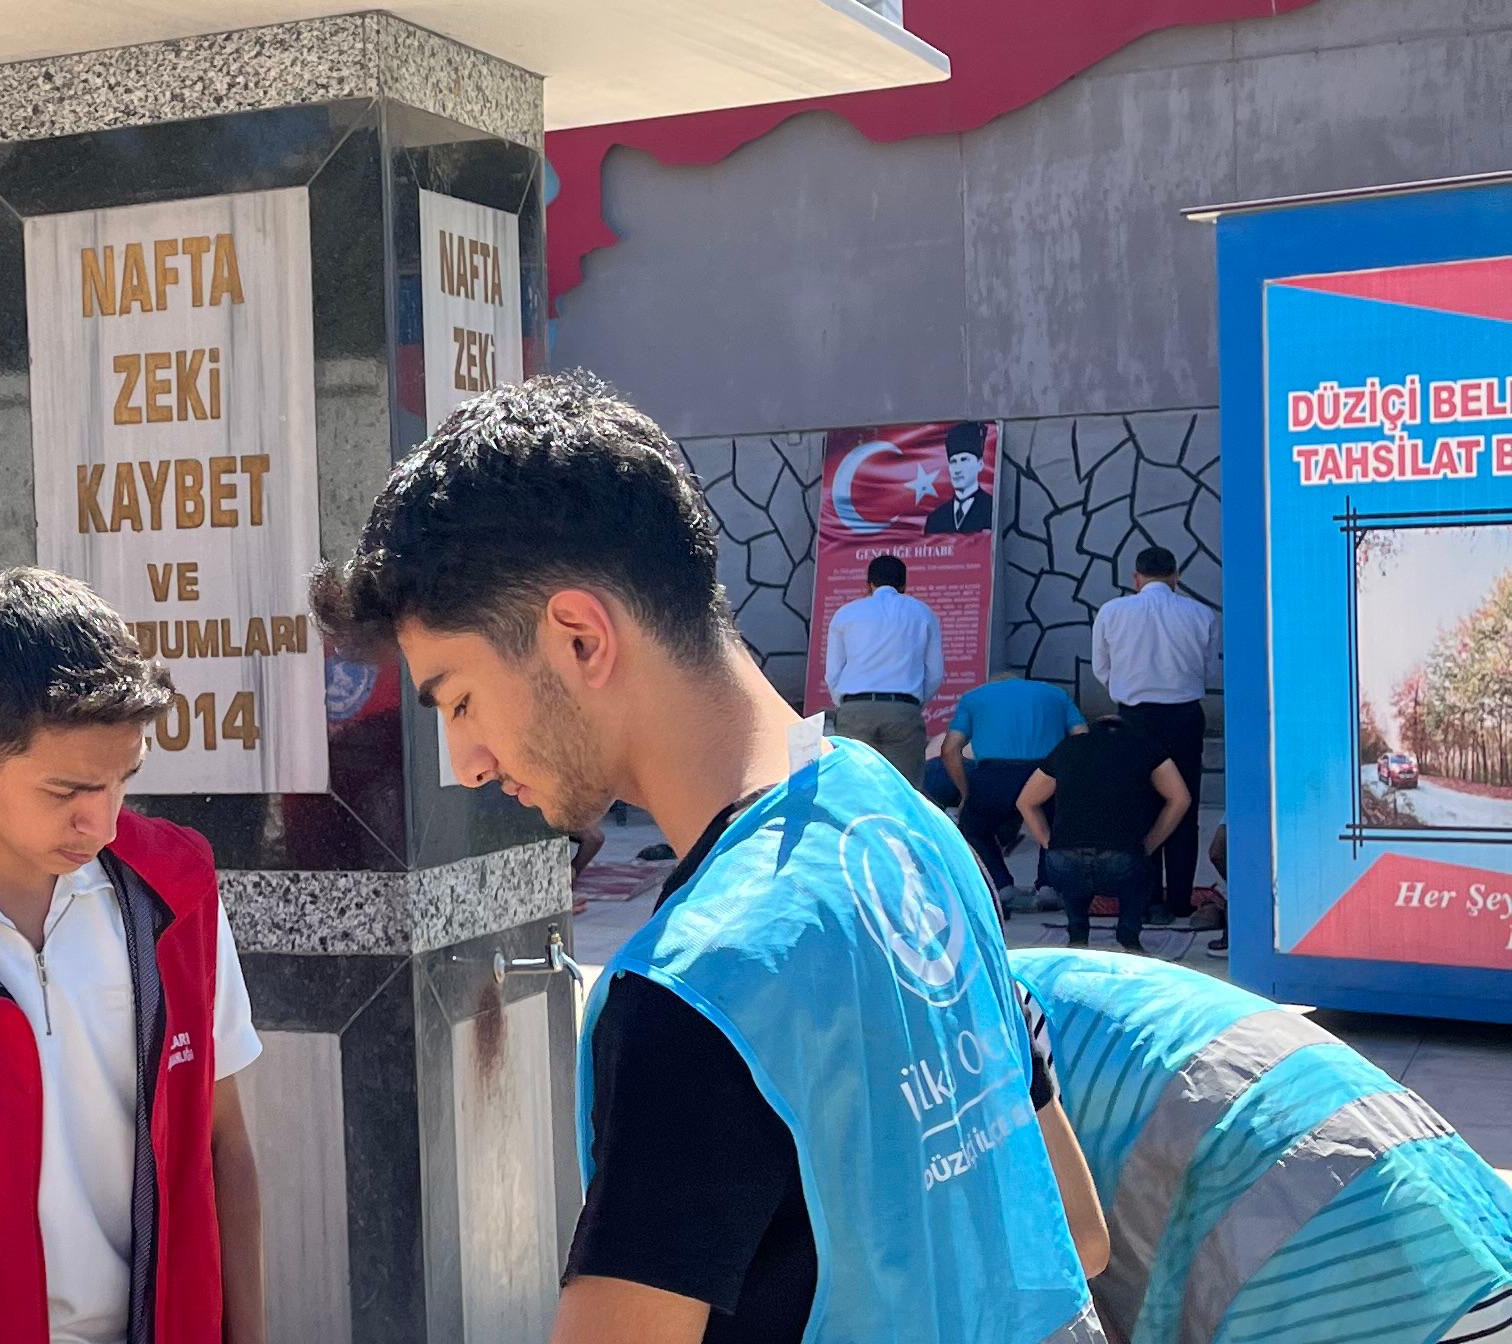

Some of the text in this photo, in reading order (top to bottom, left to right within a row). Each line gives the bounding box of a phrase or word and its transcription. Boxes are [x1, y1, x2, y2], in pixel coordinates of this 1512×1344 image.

[80, 233, 245, 318] NAFTA
[439, 229, 504, 307] NAFTA
[1289, 375, 1512, 434] DÜZİÇİ BEL
[1293, 431, 1485, 485] TAHSİLAT
[76, 454, 270, 534] KAYBET
[146, 562, 200, 602] VE
[145, 691, 261, 752] 014
[1394, 881, 1456, 908] Her
